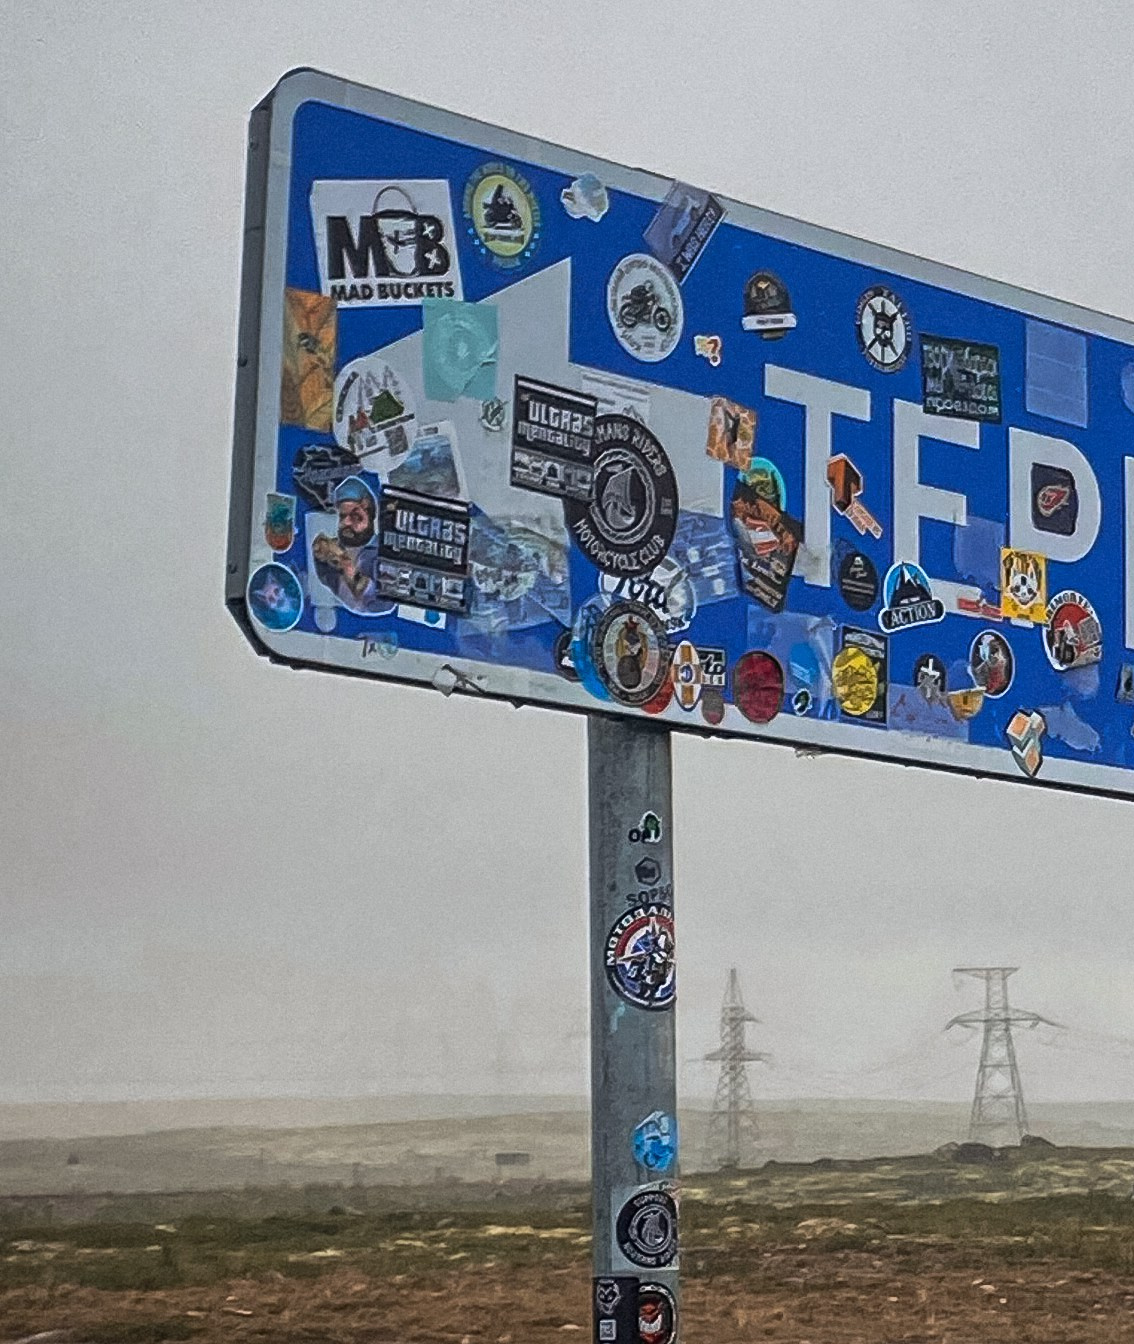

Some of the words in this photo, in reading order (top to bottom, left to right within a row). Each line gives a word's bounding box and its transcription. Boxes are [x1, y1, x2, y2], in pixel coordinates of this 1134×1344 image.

[330, 284, 374, 302] MAD
[377, 281, 455, 301] BUCKETS
[640, 534, 666, 566] CLUB
